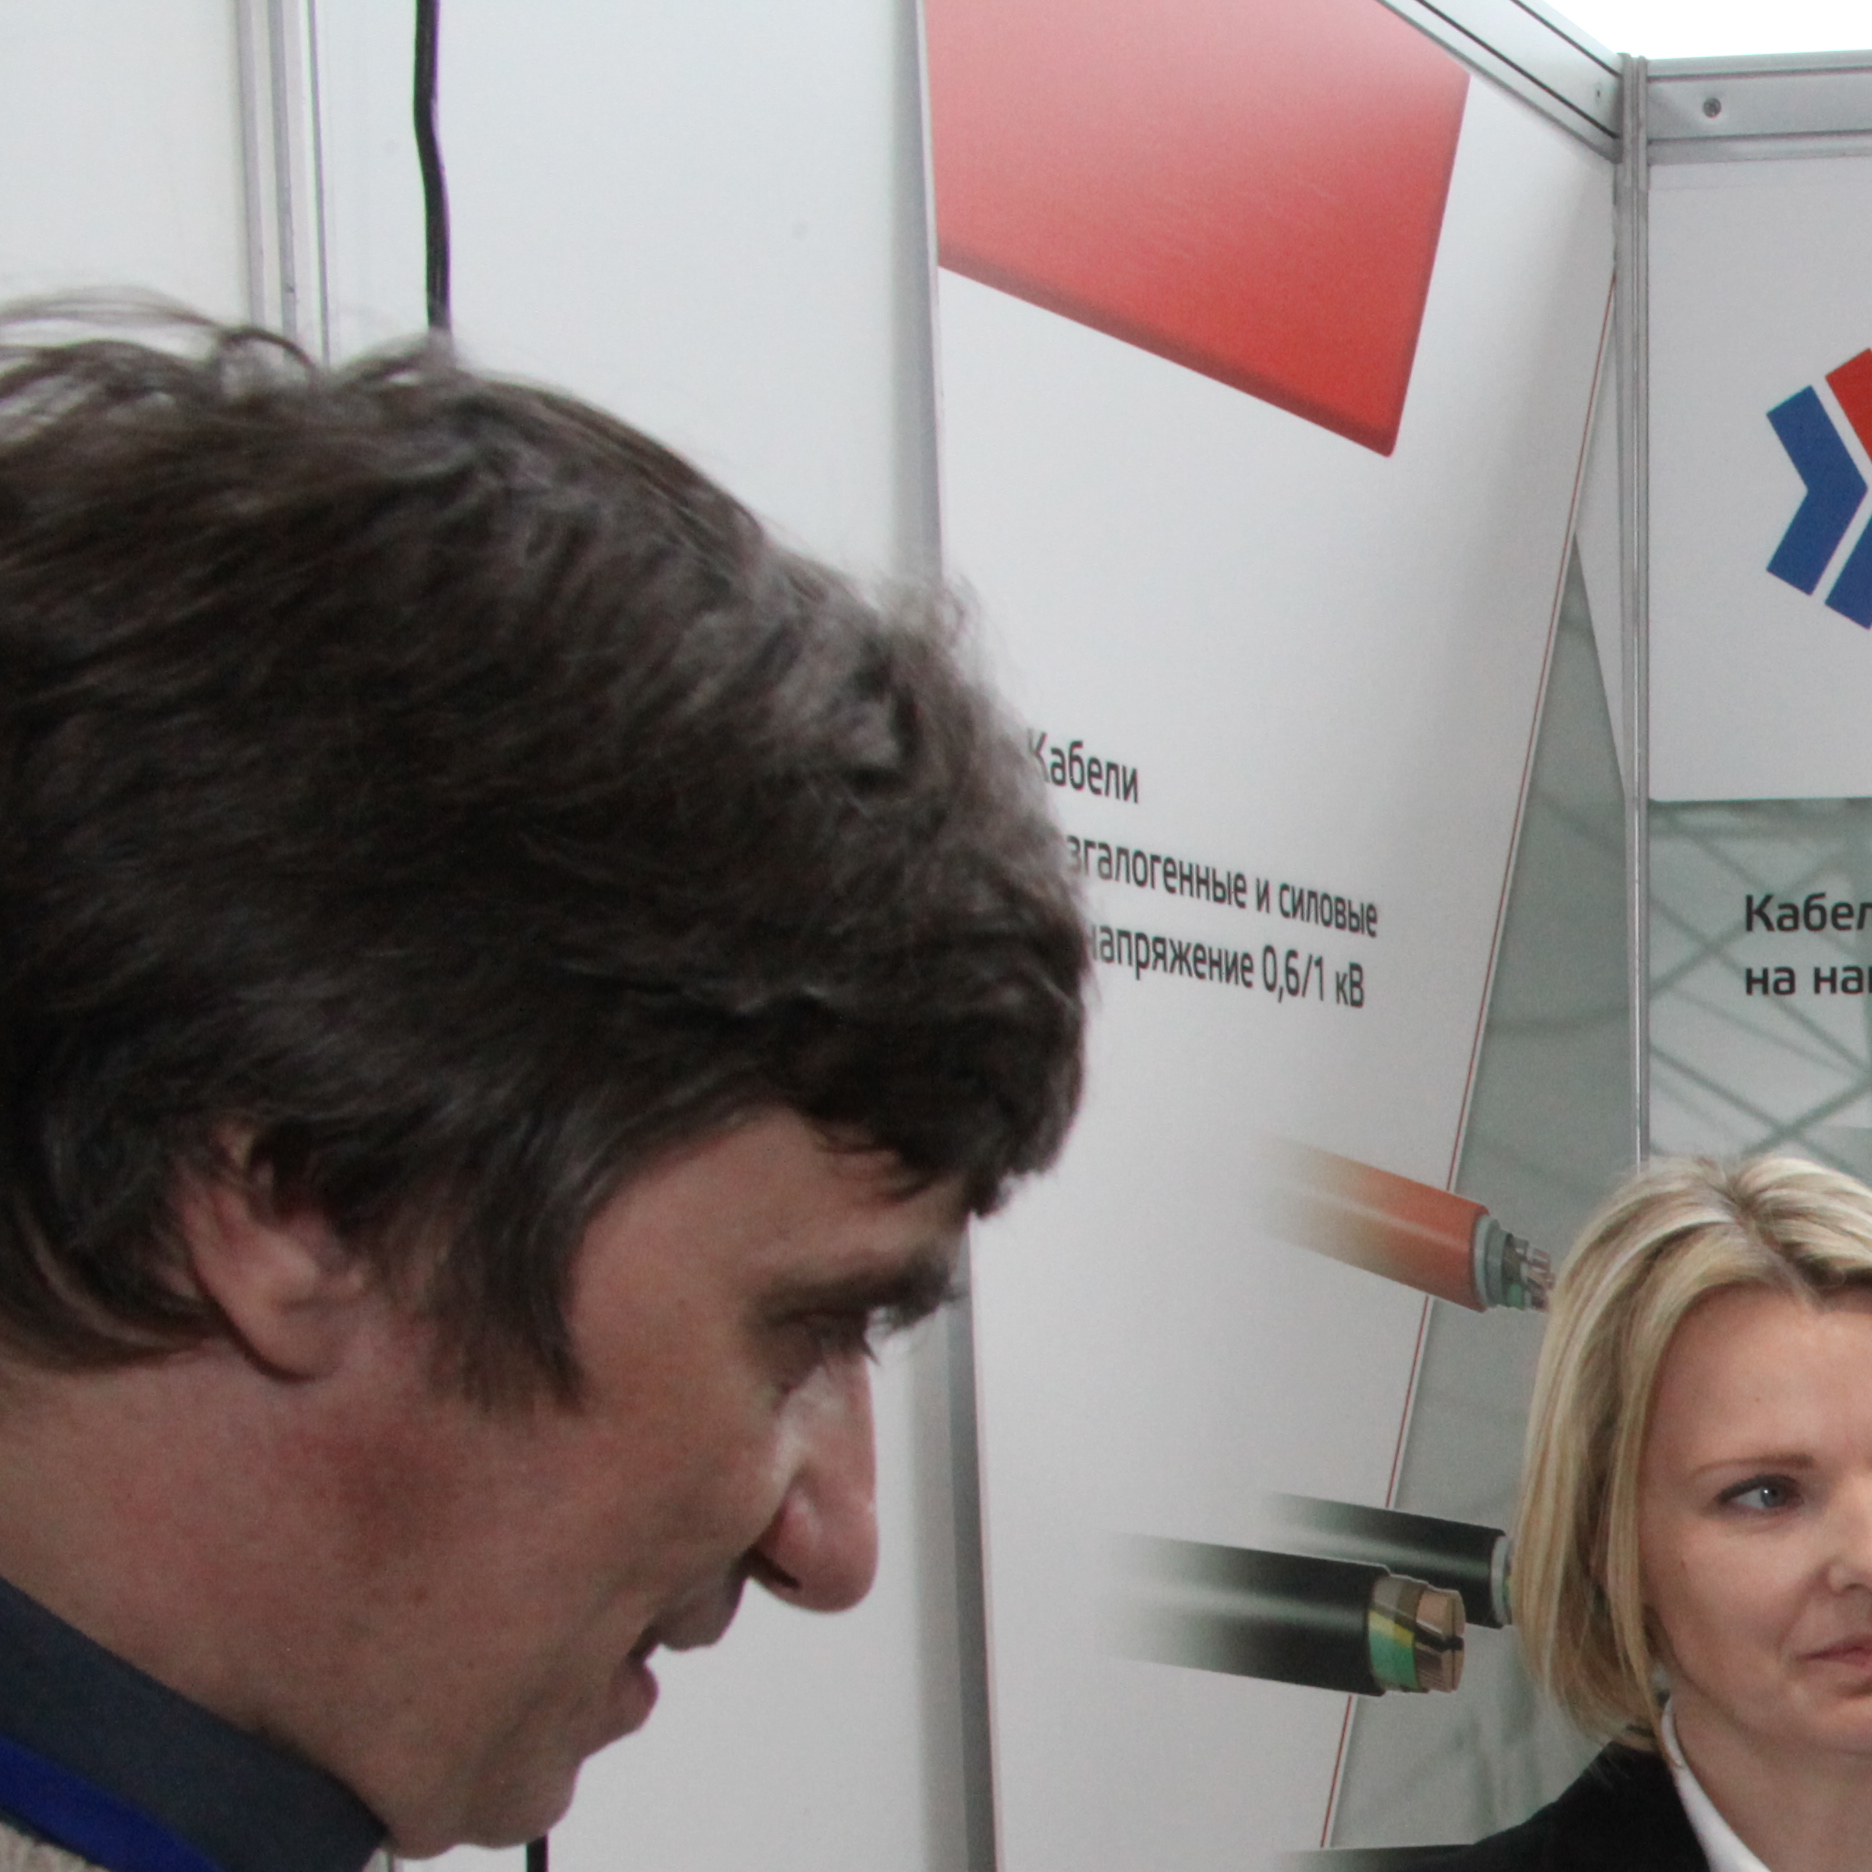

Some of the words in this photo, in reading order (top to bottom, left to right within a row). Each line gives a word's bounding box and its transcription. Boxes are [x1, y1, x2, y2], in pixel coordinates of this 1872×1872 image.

[1027, 728, 1139, 804] Кабели
[1067, 834, 1246, 910] згалогенные
[1255, 878, 1270, 914] и
[1278, 882, 1378, 939] силовые
[1262, 944, 1324, 1003] 0,6/1
[1335, 961, 1365, 1008] кВ
[1744, 965, 1796, 996] на
